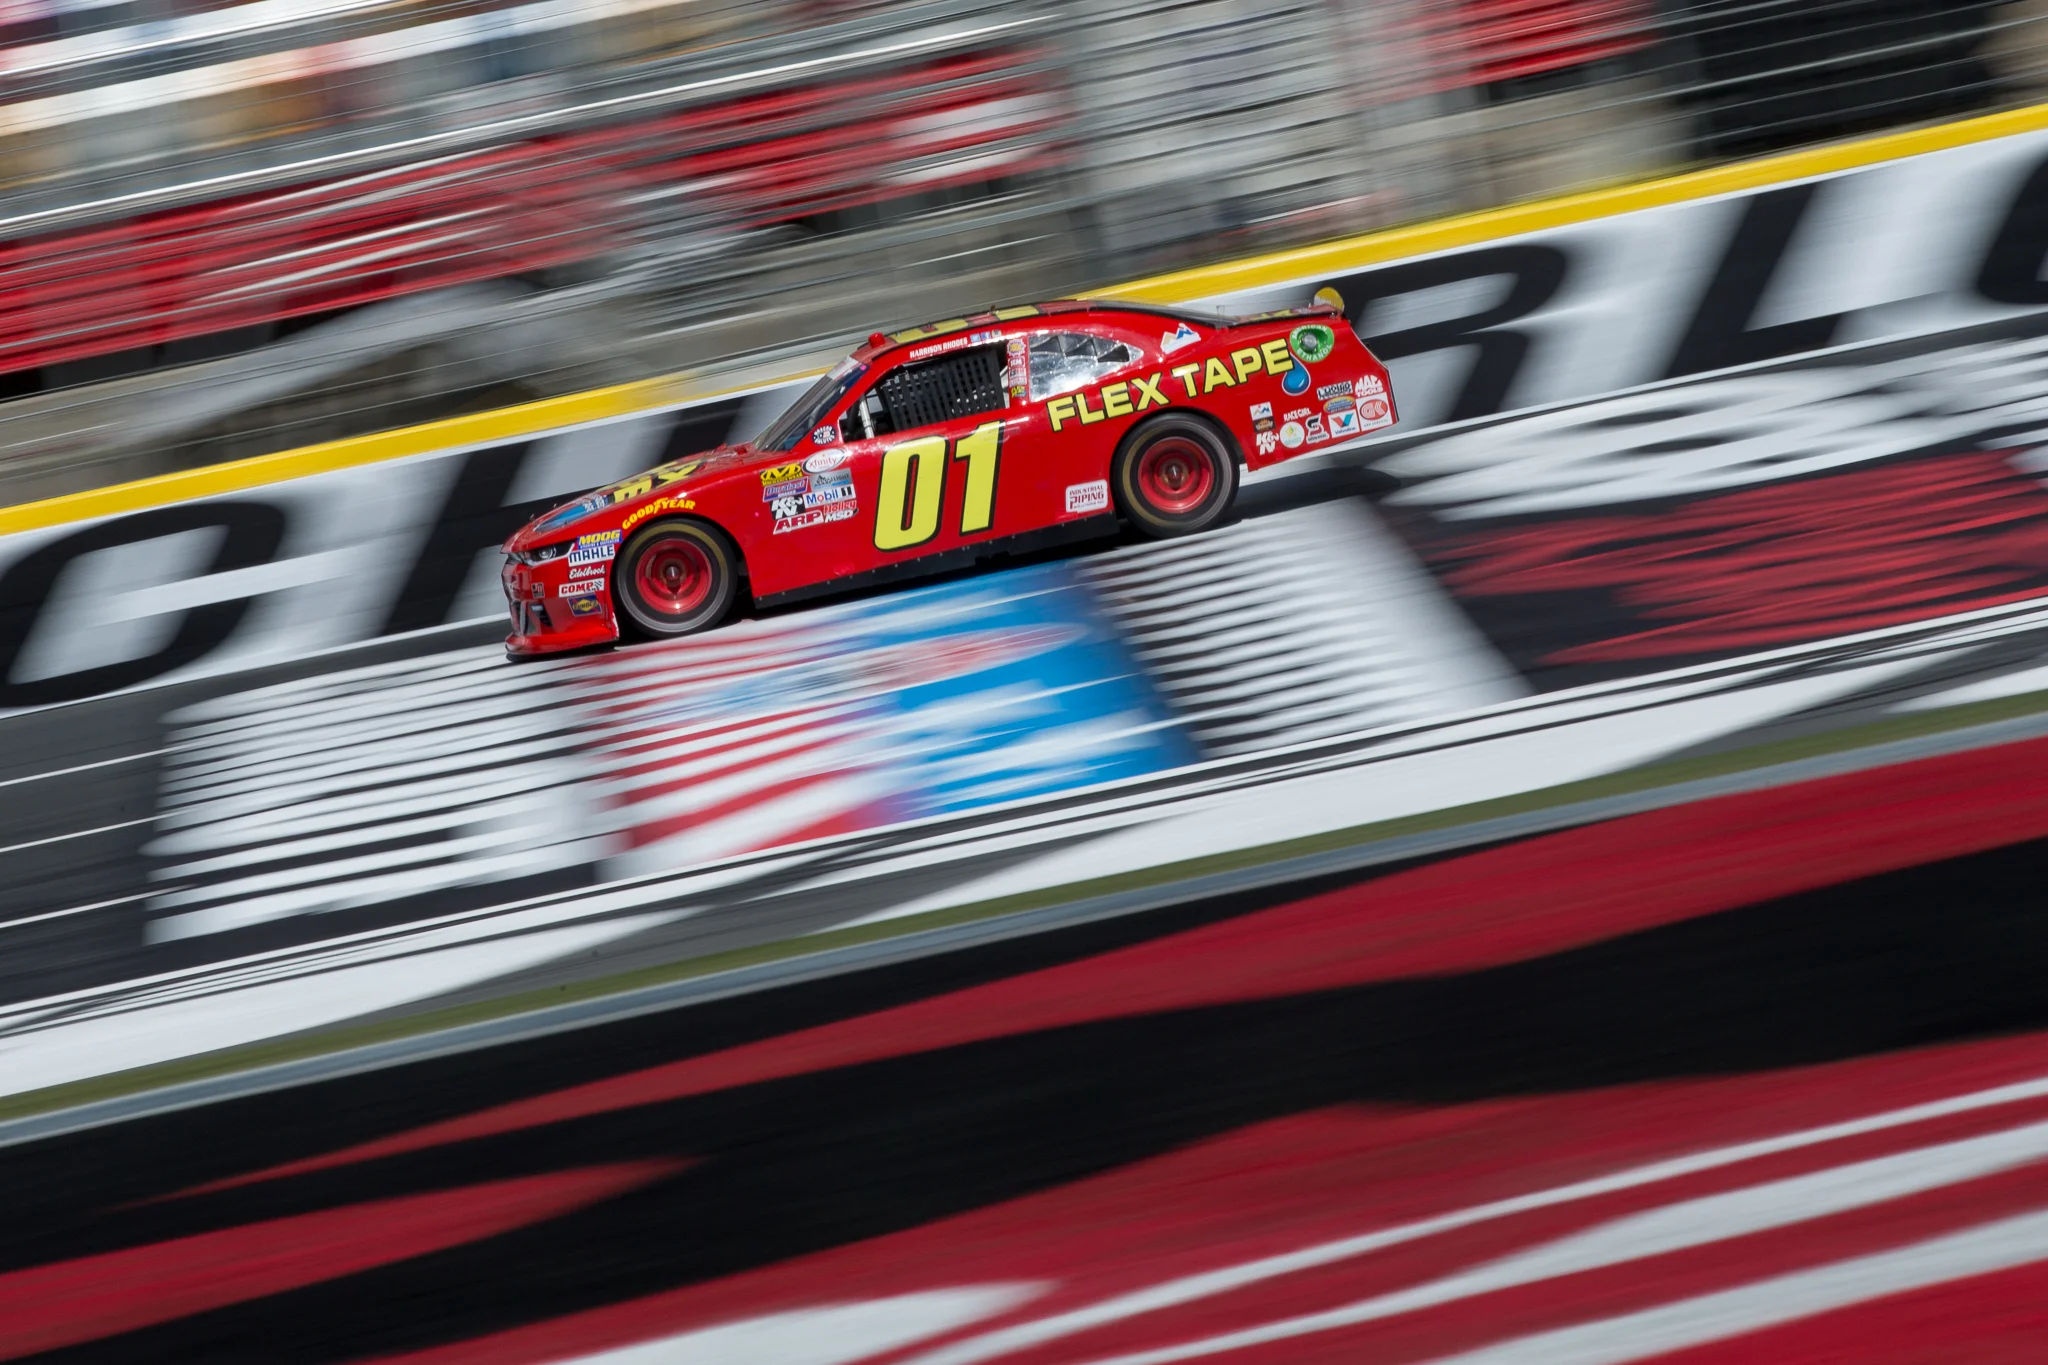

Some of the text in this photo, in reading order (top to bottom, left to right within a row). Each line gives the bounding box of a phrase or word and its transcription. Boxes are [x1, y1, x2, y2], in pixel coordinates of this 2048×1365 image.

[909, 337, 968, 359] HARRISON RHODES
[1297, 344, 1333, 362] ETHANOL
[1046, 337, 1295, 433] FLEX TAPE
[809, 455, 837, 468] xfinity
[873, 419, 1005, 552] 01
[1069, 484, 1104, 496] INDUSTRIAL
[806, 490, 839, 506] Mobil
[1069, 491, 1105, 510] PIPING
[621, 497, 697, 530] GOODYEAR
[775, 511, 822, 532] ARP
[824, 509, 855, 524] MSD
[578, 529, 621, 546] MOOG
[568, 545, 615, 564] MAHLE
[568, 564, 606, 580] Edelbrock
[561, 581, 595, 595] COMP
